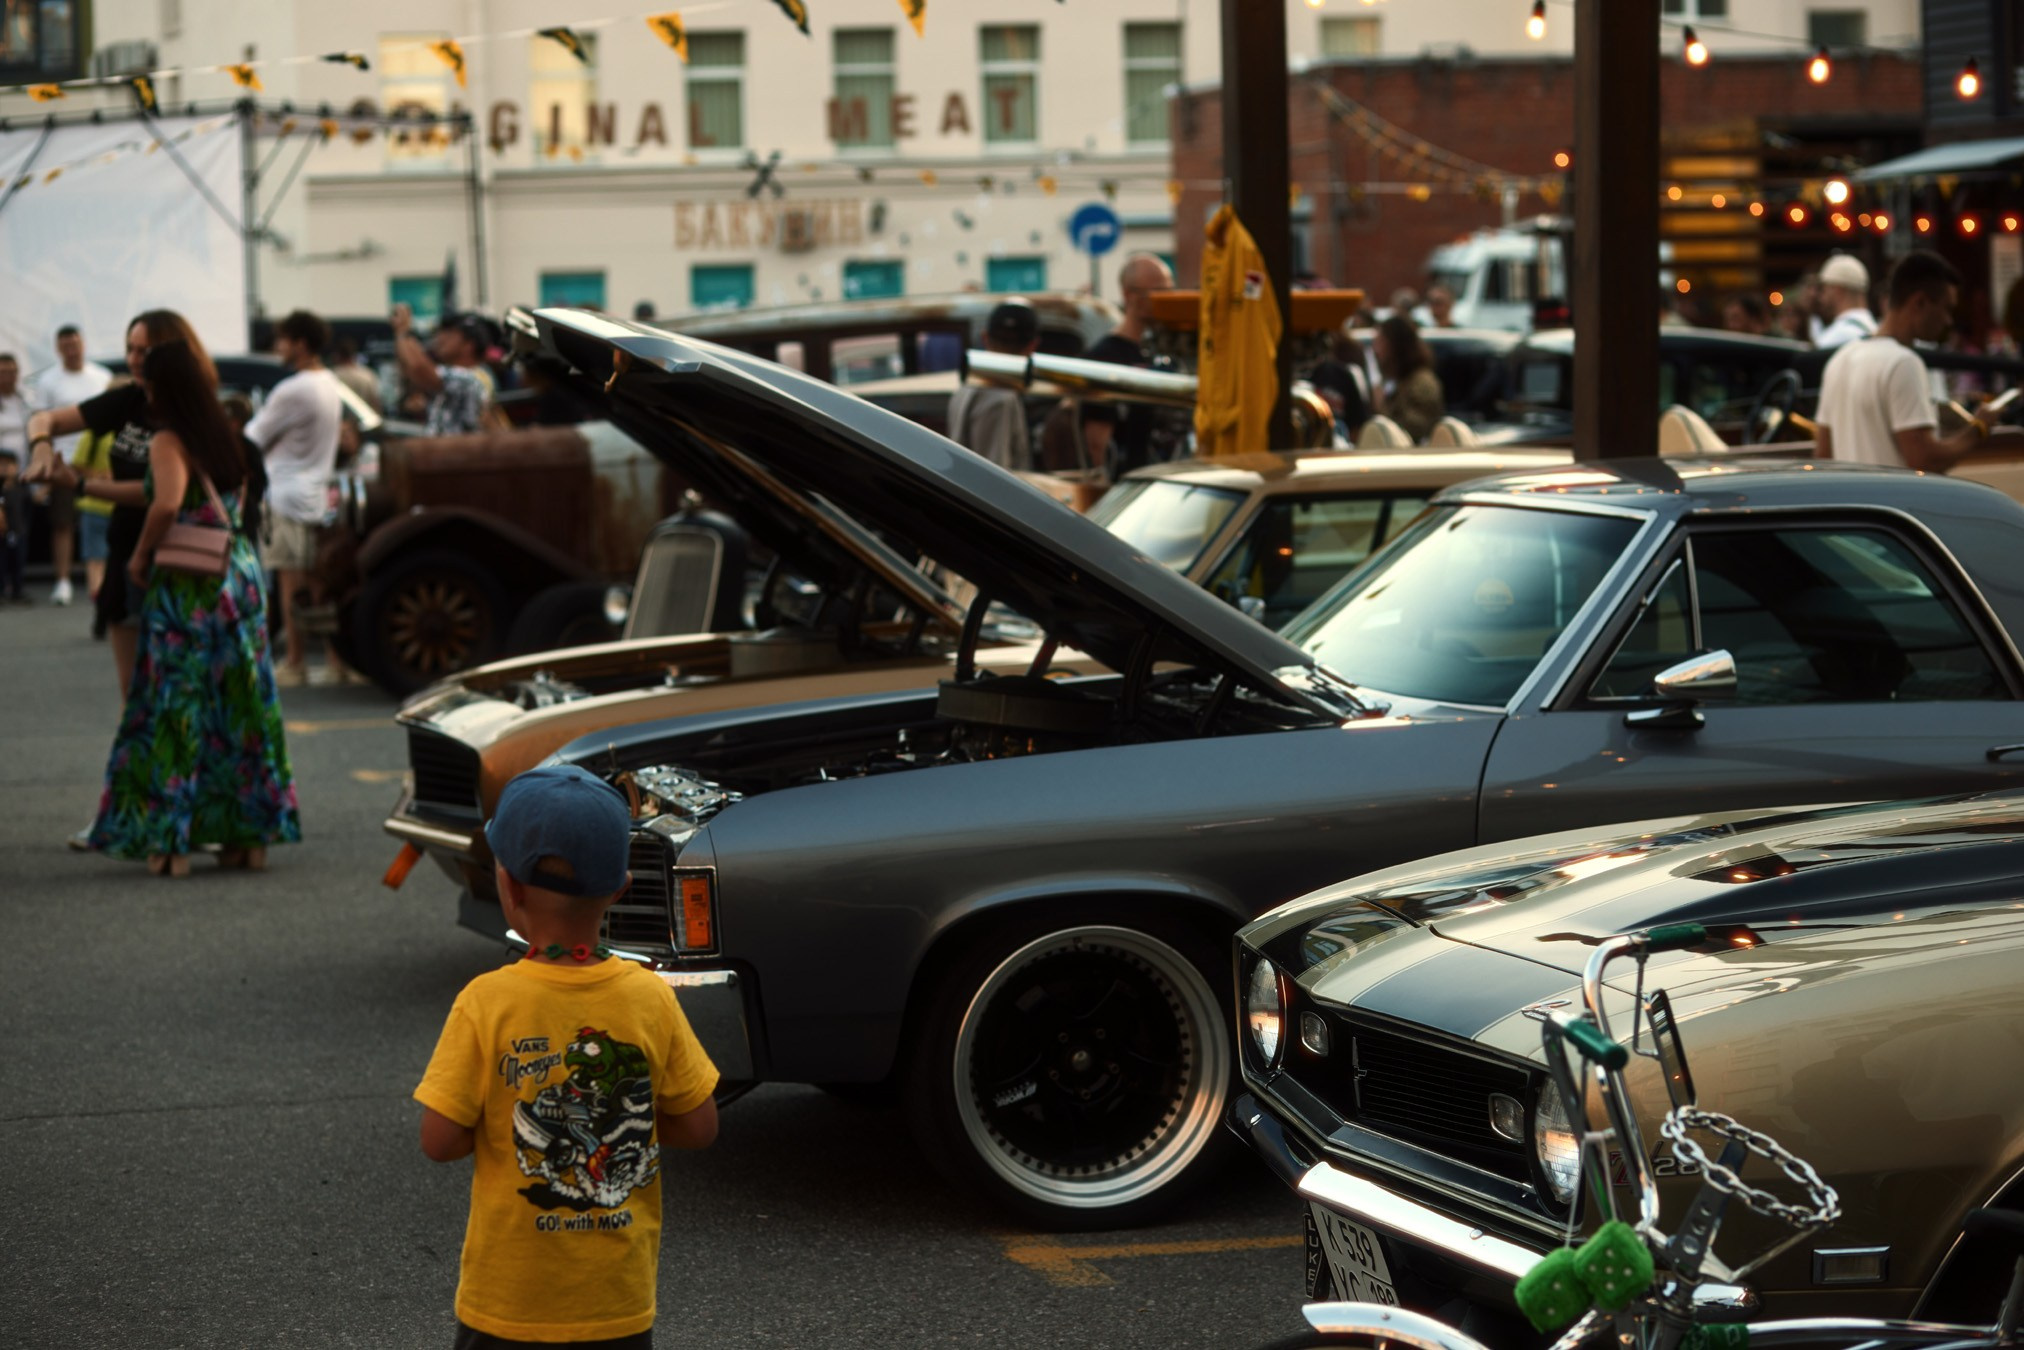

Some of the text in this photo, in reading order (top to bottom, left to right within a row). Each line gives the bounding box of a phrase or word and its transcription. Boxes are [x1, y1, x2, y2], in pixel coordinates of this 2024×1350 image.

[826, 88, 1019, 142] MEAT
[511, 1037, 550, 1053] VANS
[535, 1214, 561, 1232] GO!
[564, 1212, 594, 1231] with
[1338, 1220, 1376, 1272] 539
